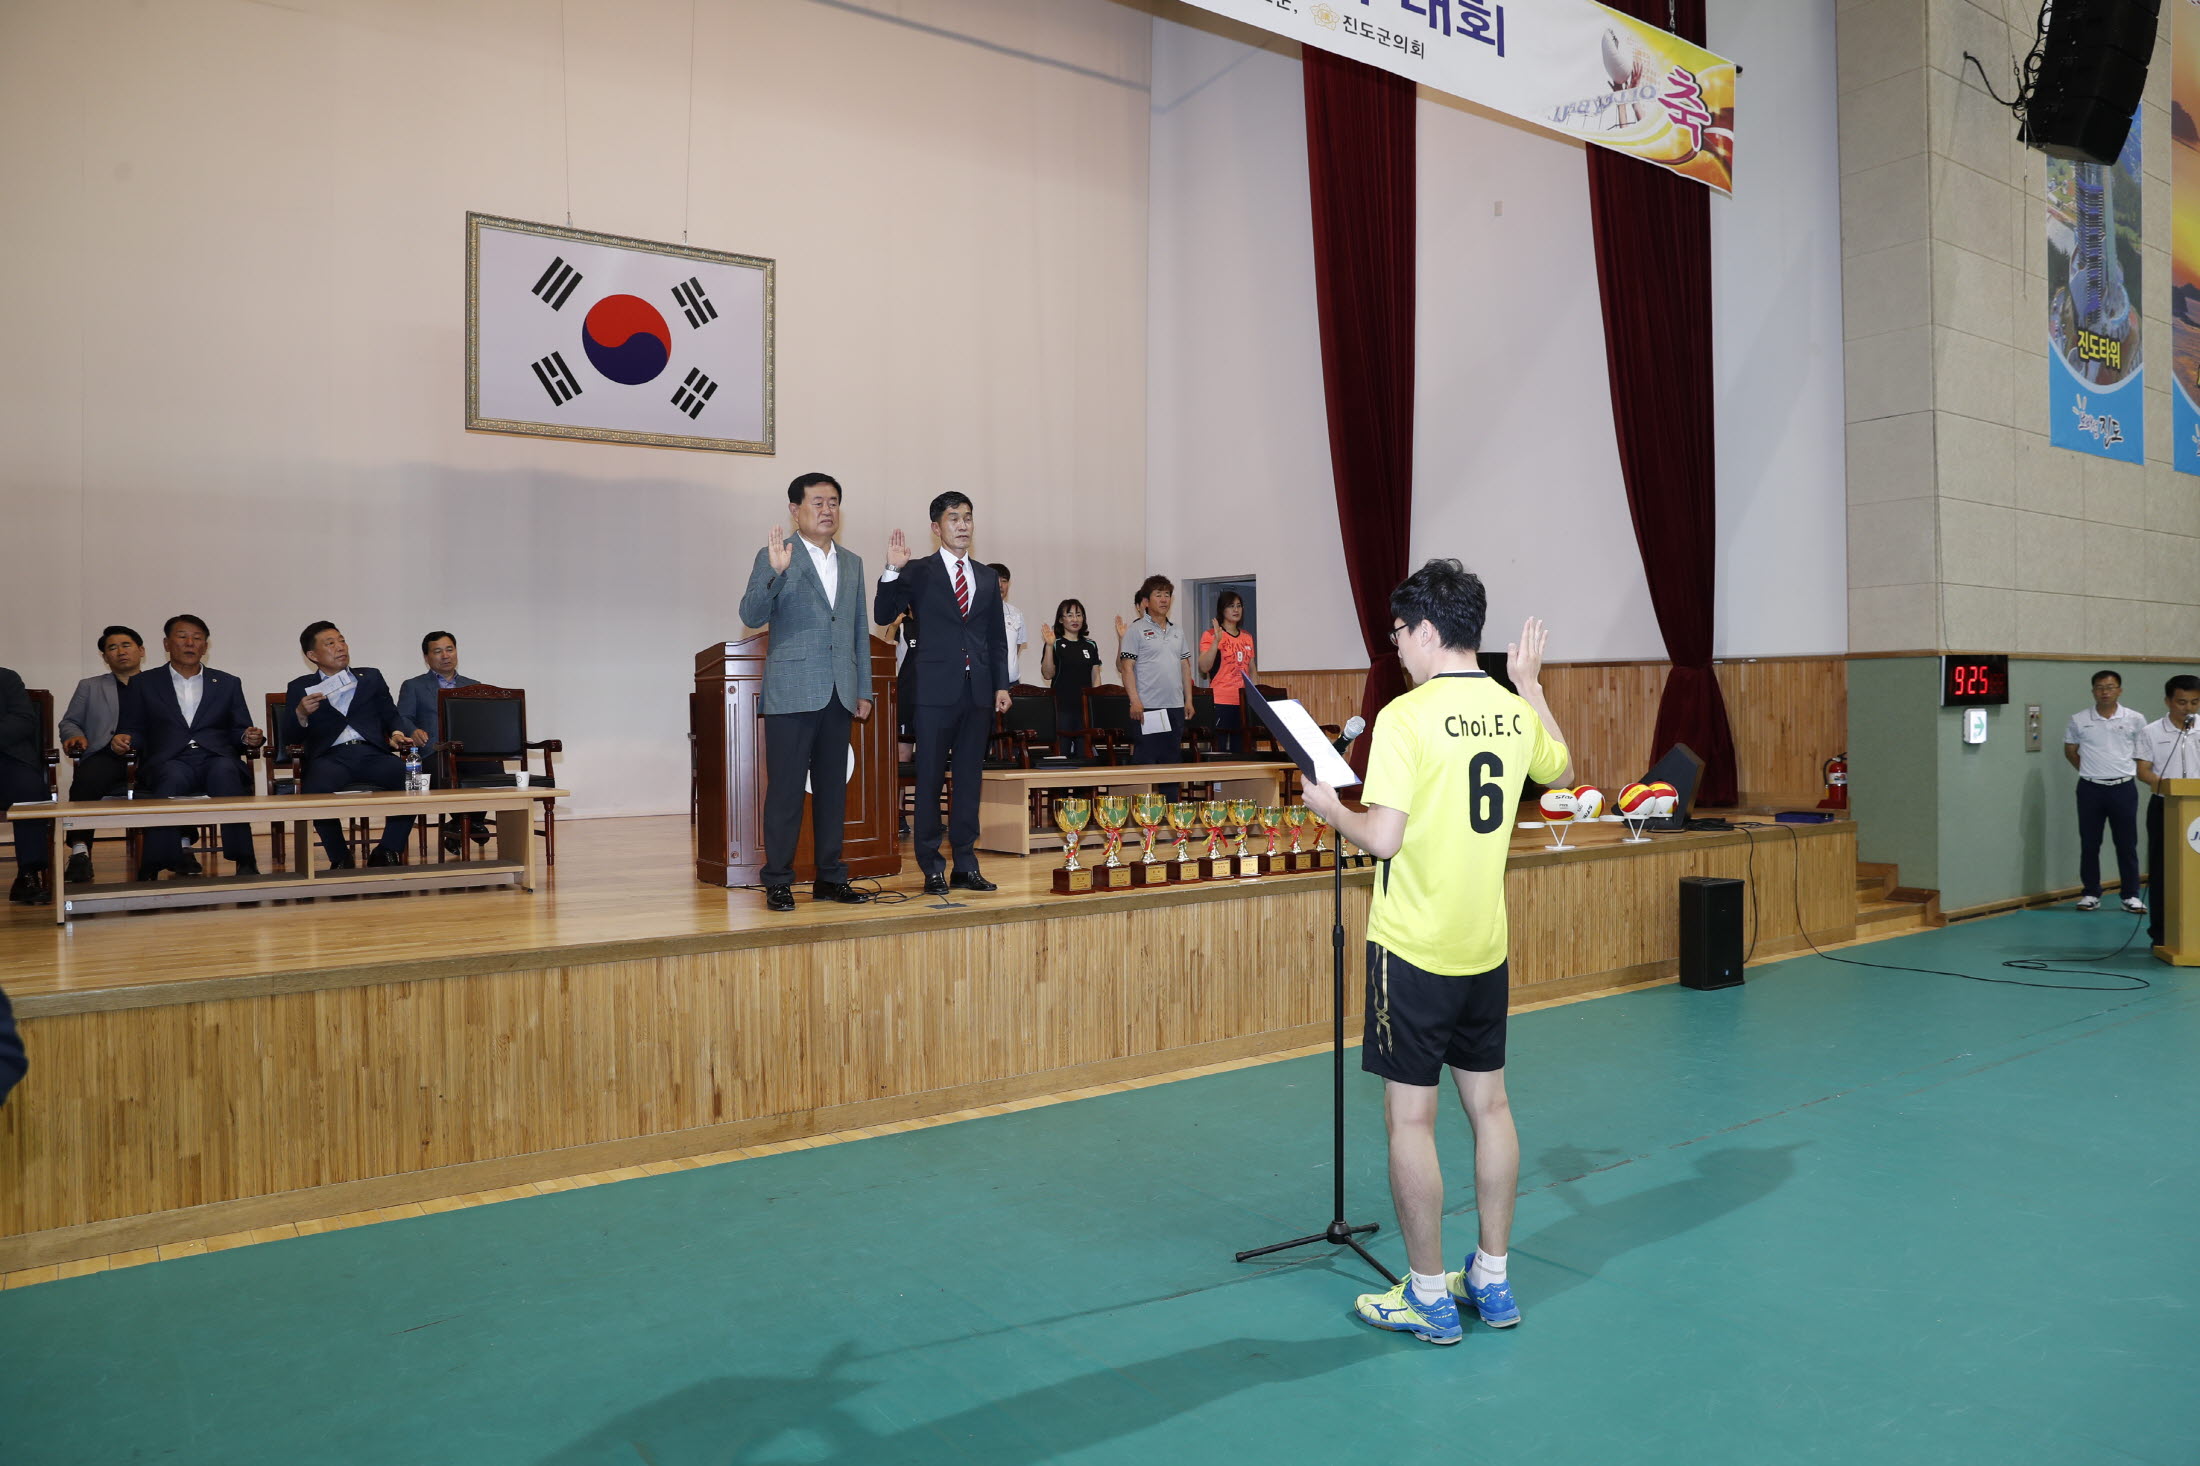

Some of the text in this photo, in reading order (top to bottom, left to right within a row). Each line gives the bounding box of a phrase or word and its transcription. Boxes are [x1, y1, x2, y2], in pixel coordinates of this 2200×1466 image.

[1342, 15, 1425, 60] 진도군의회
[2077, 330, 2121, 370] 진도타워
[1082, 649, 1090, 659] 5
[1444, 713, 1522, 738] Choi.E.C
[1468, 751, 1504, 835] 6
